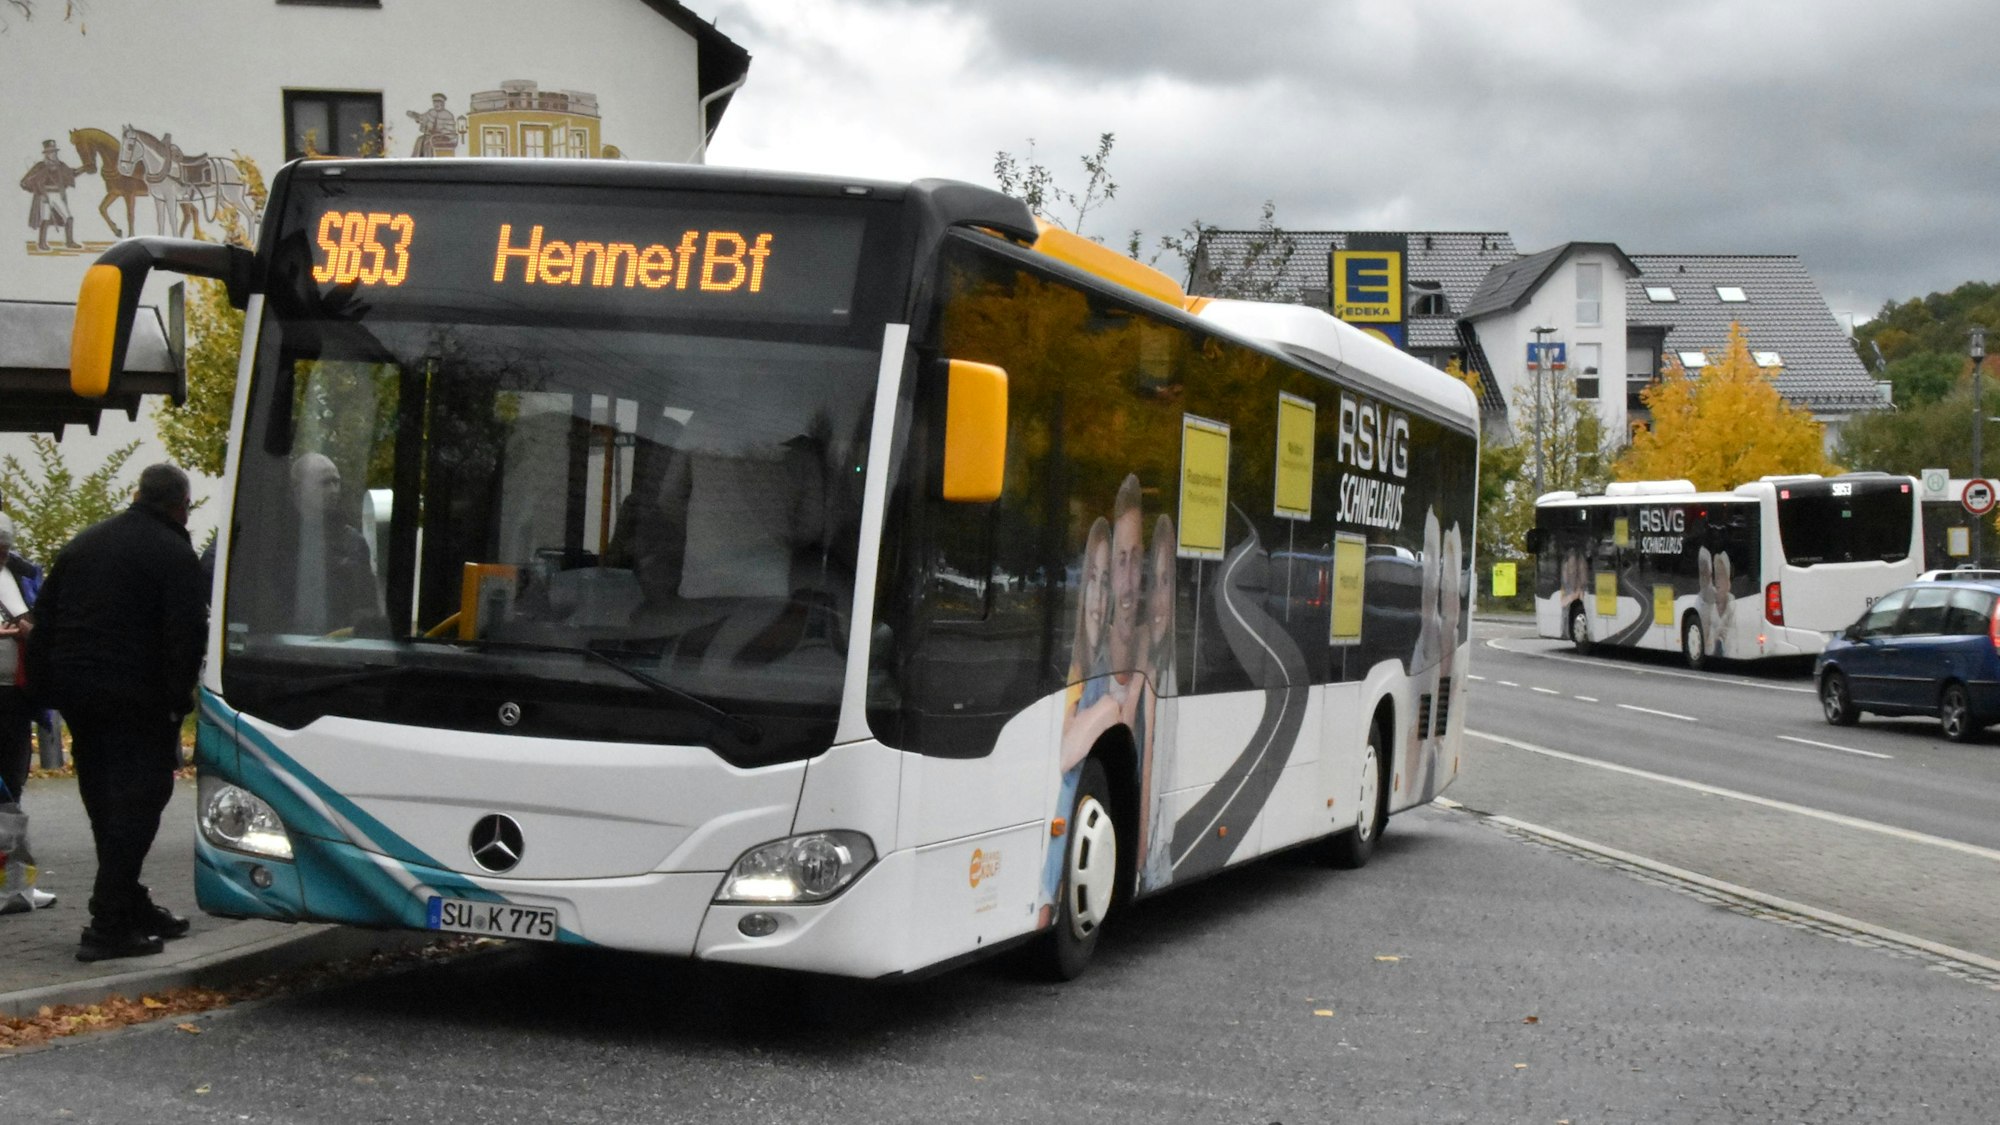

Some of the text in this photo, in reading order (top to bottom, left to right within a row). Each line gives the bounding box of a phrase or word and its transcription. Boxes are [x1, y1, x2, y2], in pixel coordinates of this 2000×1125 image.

[311, 211, 773, 292] SB53 Hennef Bf
[1346, 258, 1389, 303] E
[1345, 307, 1390, 316] EDEKA
[1337, 391, 1409, 478] RSVG
[1336, 472, 1405, 530] SCHNELLBUS
[1640, 509, 1685, 533] RSVG
[1641, 536, 1683, 555] SCHNELLBUS
[442, 902, 472, 928] SU
[489, 907, 504, 931] K
[510, 909, 554, 936] 775
